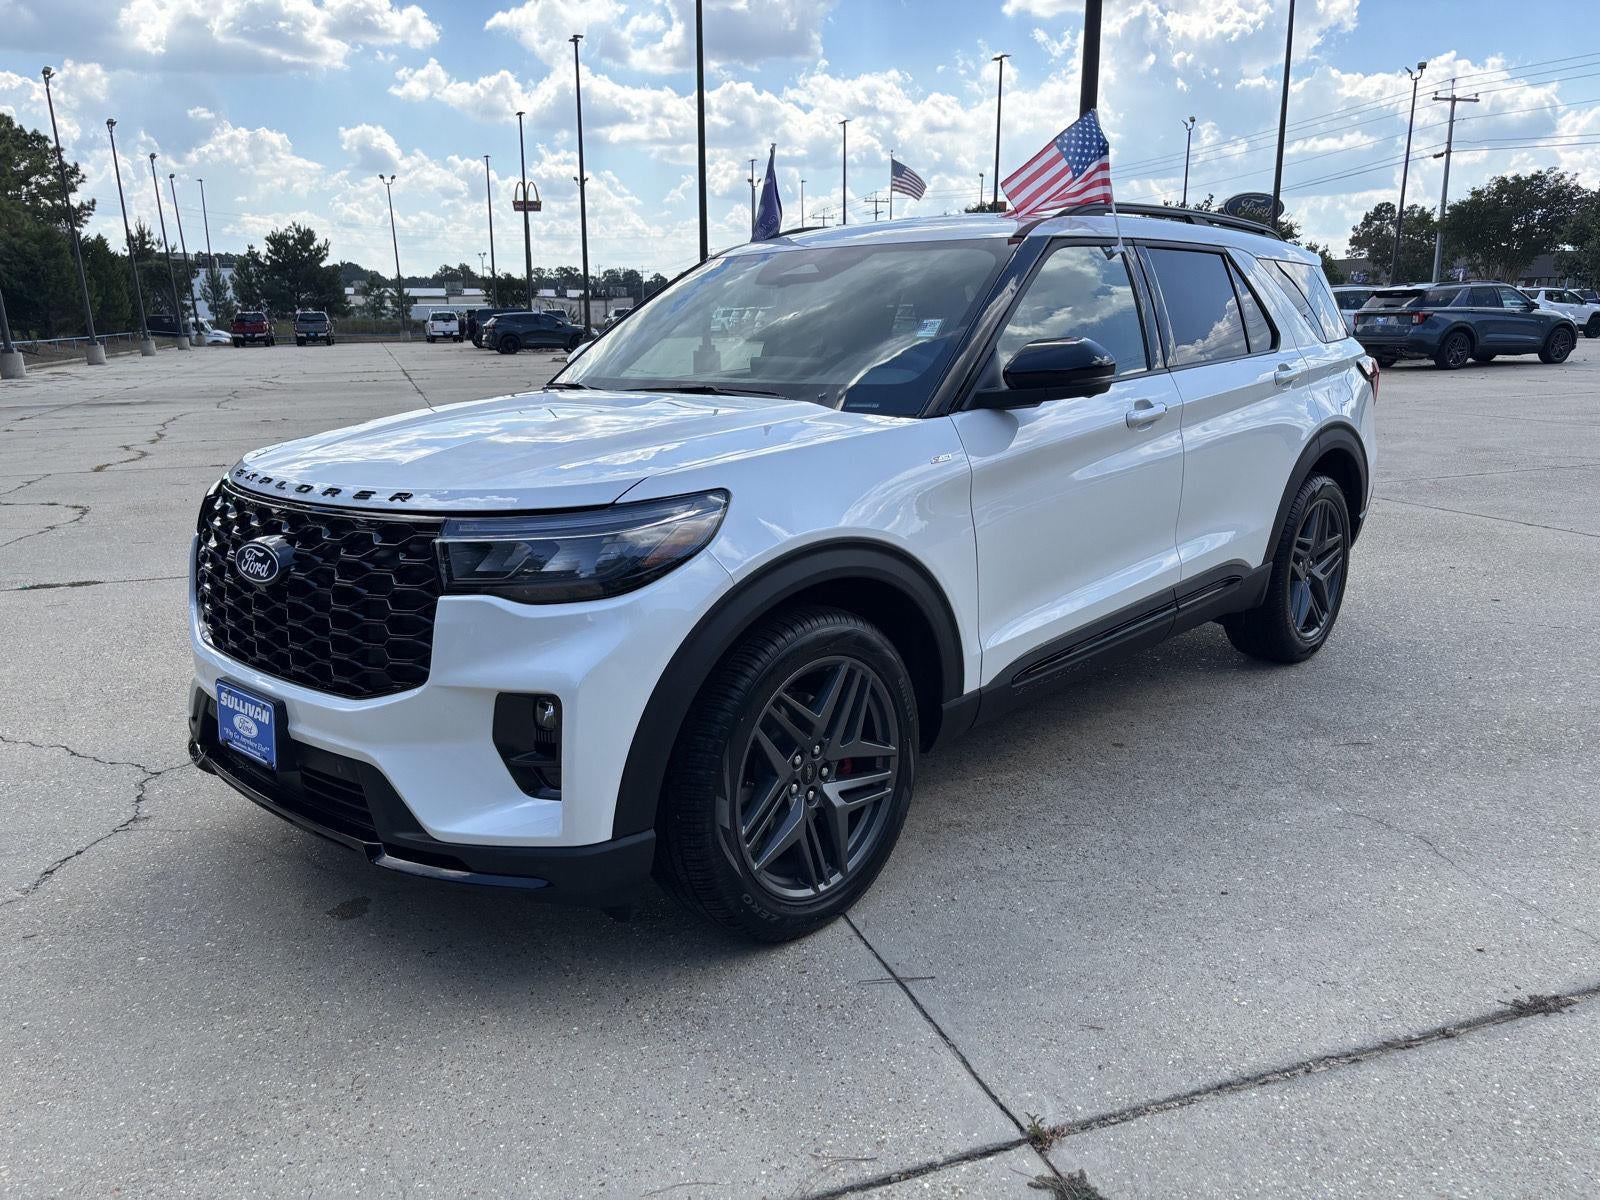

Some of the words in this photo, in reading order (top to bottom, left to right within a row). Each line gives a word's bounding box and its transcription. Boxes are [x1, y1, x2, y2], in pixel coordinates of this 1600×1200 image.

[1237, 198, 1272, 217] Ford
[234, 468, 414, 503] EXPLORER
[241, 547, 271, 578] Ford
[220, 692, 270, 725] SULLIVAN
[239, 716, 254, 735] Ford
